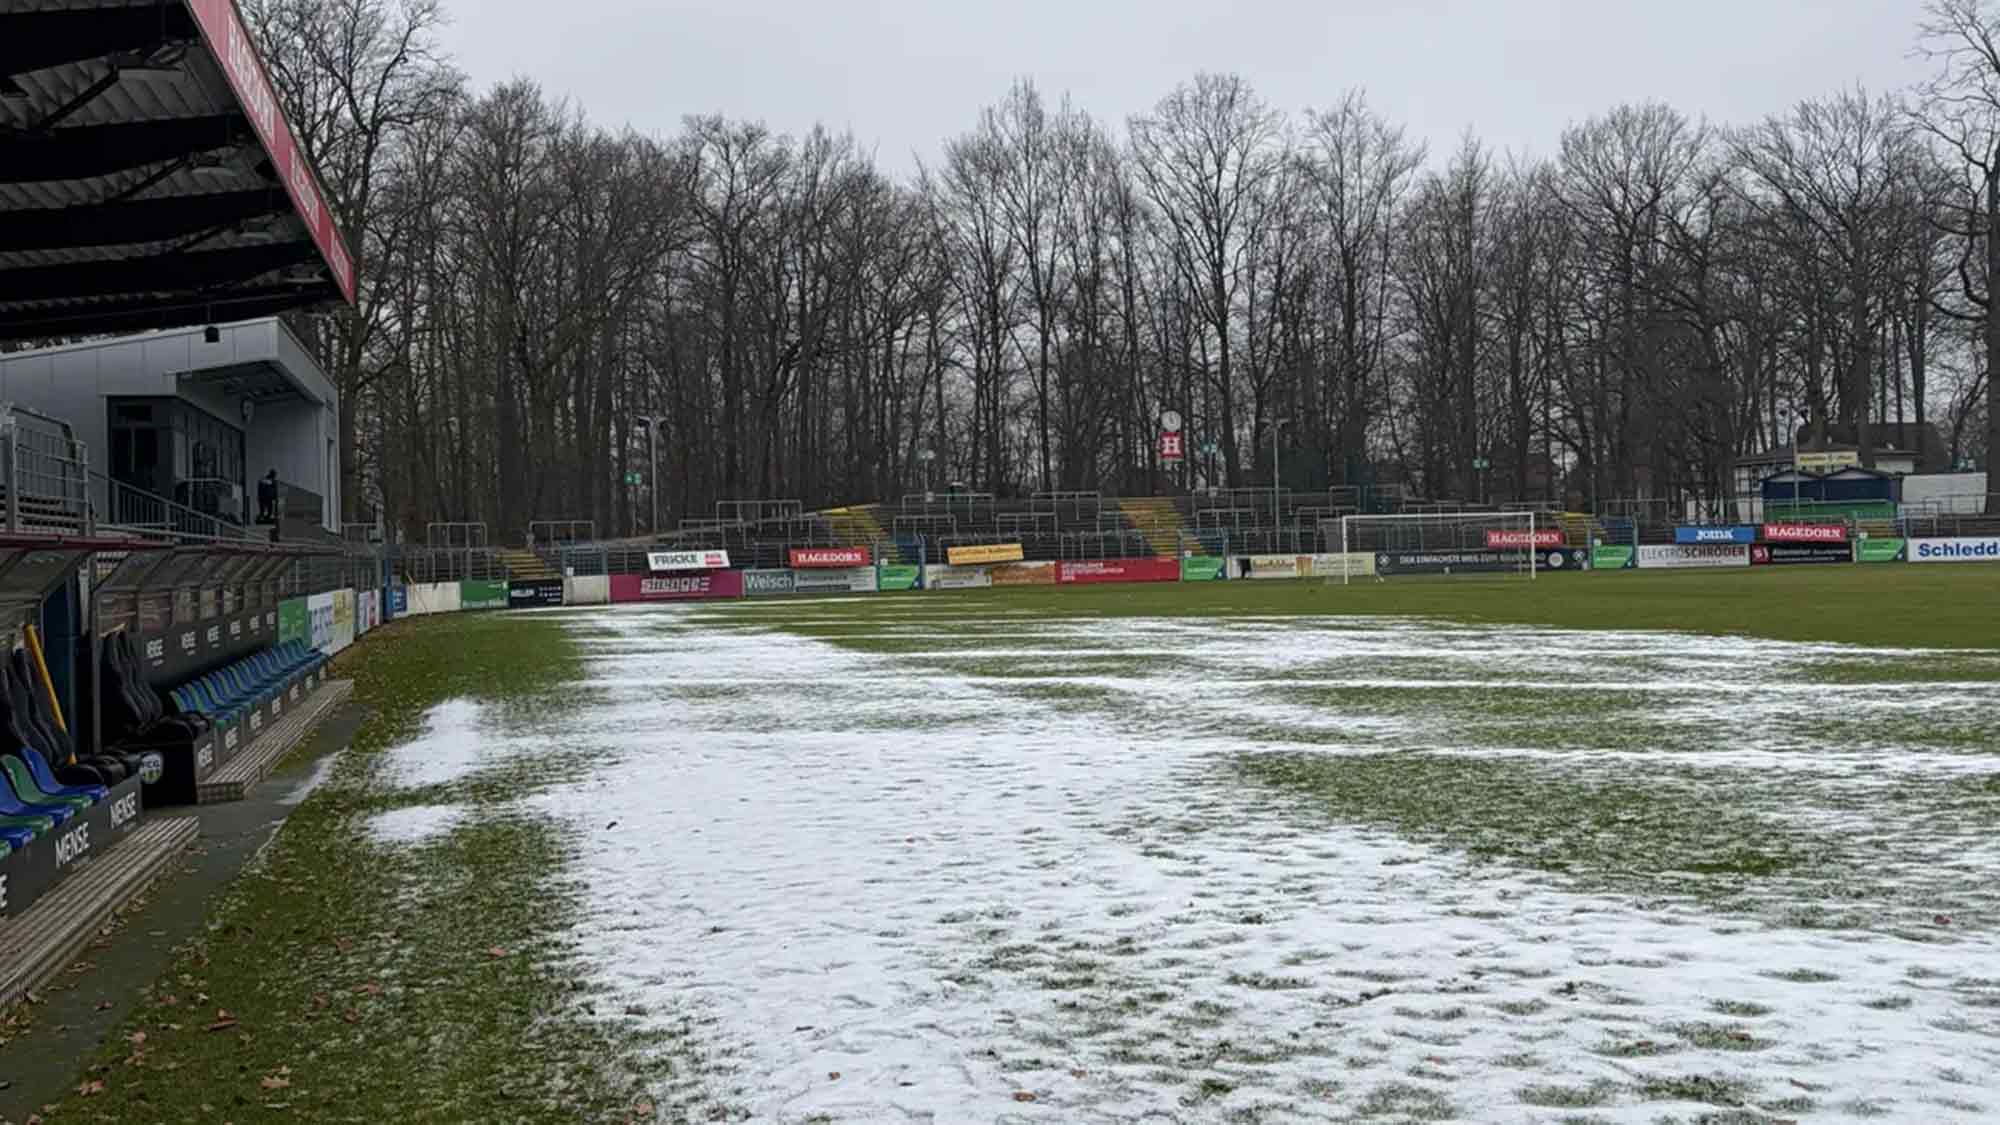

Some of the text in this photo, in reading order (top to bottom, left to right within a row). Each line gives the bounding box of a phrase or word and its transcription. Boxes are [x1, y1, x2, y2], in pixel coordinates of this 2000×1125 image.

[1162, 435, 1181, 455] H
[1489, 532, 1560, 544] HAGEDORN
[1768, 526, 1840, 538] HAGEDORN
[1918, 541, 2000, 556] Schledd
[654, 552, 697, 565] FRICKE
[798, 552, 862, 563] HAGEDORN
[745, 573, 793, 590] Welsch
[108, 791, 137, 829] MENSE
[55, 821, 90, 869] MENSE
